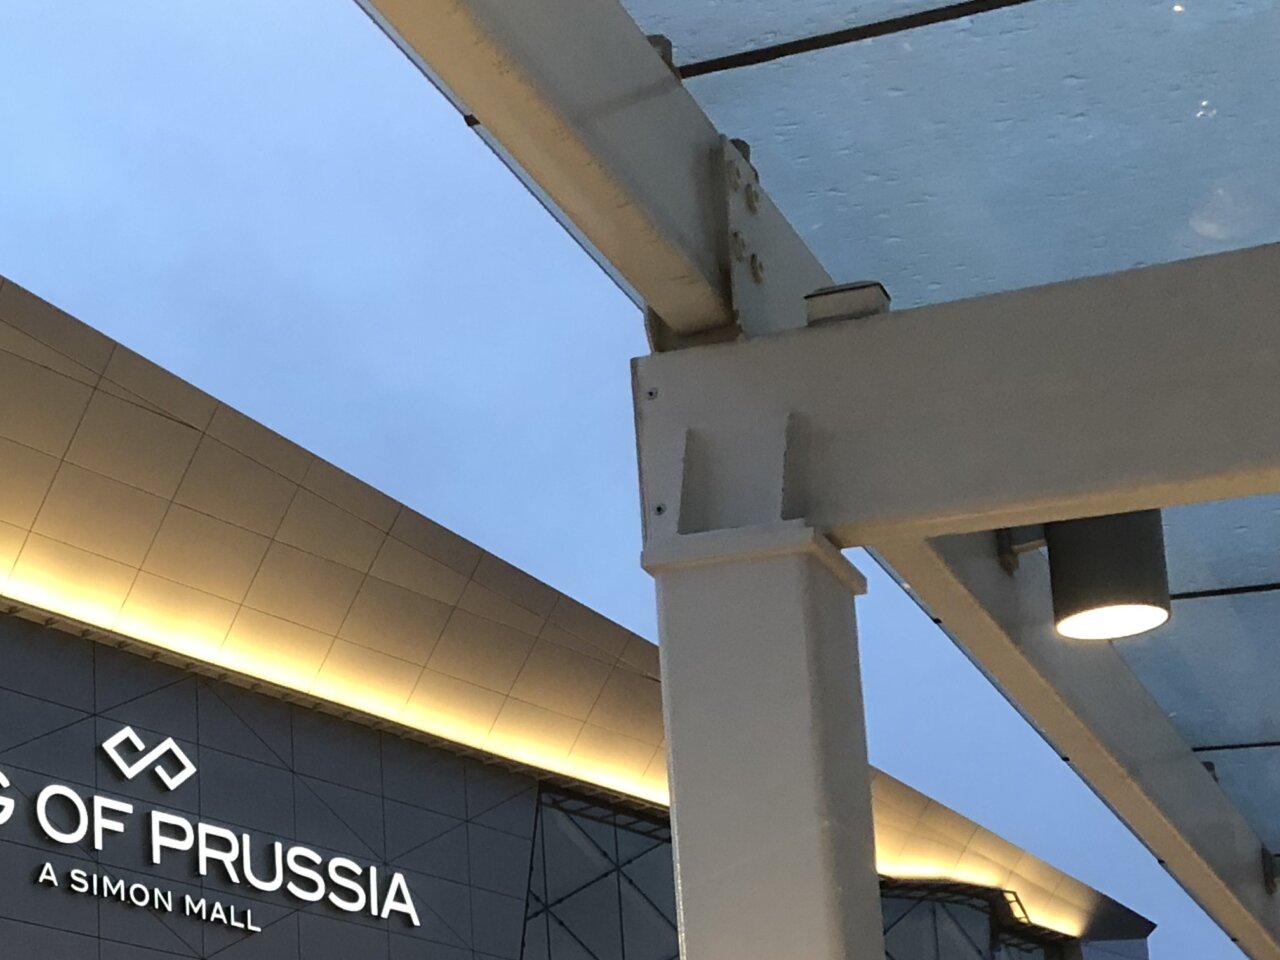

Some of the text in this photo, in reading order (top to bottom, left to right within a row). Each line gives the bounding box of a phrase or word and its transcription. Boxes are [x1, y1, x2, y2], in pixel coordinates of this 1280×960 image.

[36, 785, 134, 851] OF
[151, 810, 421, 928] PRUSSIA
[38, 862, 262, 933] A SIMON MALL
